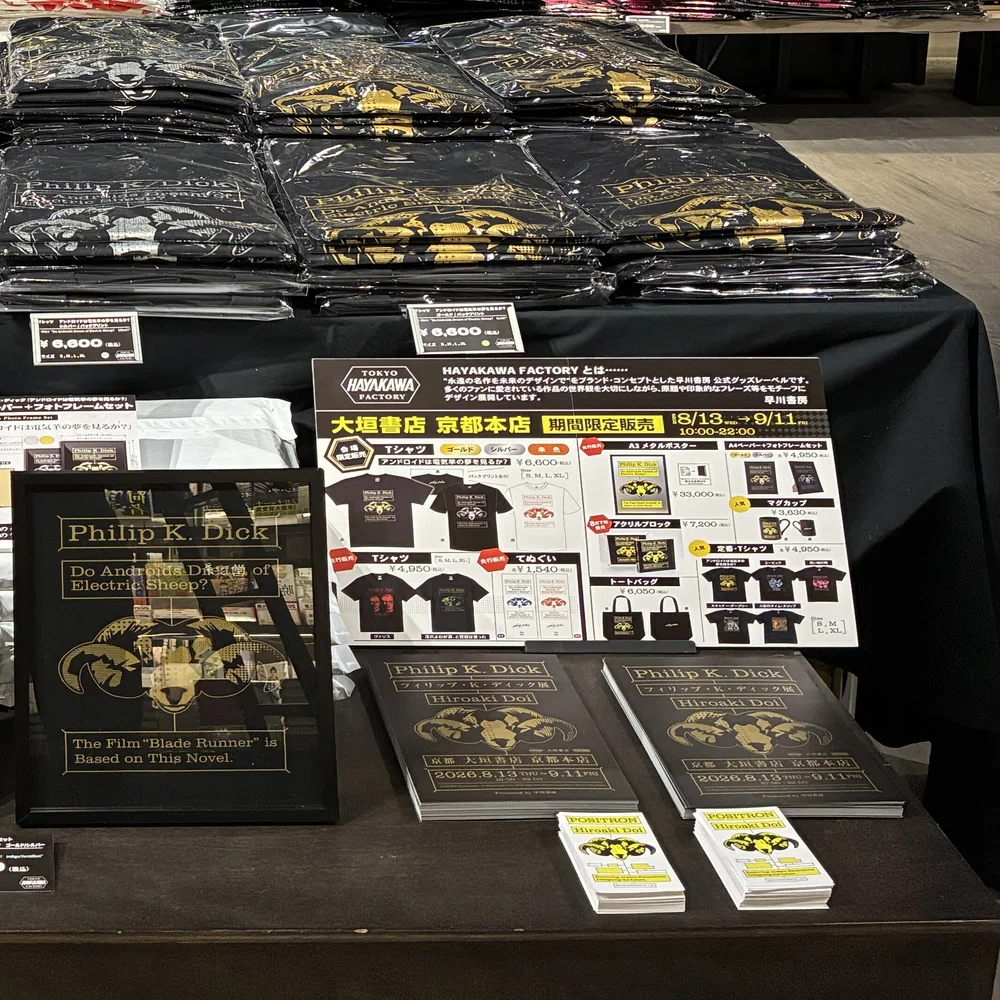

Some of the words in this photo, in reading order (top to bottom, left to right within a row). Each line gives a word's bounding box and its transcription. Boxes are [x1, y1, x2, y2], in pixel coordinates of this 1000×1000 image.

[443, 366, 516, 375] HAYAKAWA
[519, 366, 579, 375] FACTORY
[347, 378, 414, 391] HAYAKAWA
[764, 396, 808, 405] 早川書房
[677, 412, 723, 426] 8/13
[753, 412, 797, 426] 9/11
[331, 416, 426, 434] 大垣書店
[436, 416, 531, 434] 京都本店
[548, 418, 655, 432] 期間限定販売
[679, 427, 756, 436] 10:00-22:00
[384, 445, 426, 454] Tシャツ
[613, 520, 671, 528] アクリルブロック
[68, 525, 154, 544] Philip
[163, 524, 192, 541] K.
[202, 524, 269, 540] Dick
[371, 554, 409, 563] Tシャツ
[515, 553, 557, 563] てぬぐい
[70, 566, 95, 577] Do
[100, 565, 181, 576] Androids
[253, 564, 270, 576] of
[71, 580, 140, 591] Electric
[146, 579, 207, 592] Sheep?
[394, 665, 457, 675] Philip
[463, 665, 486, 673] K.
[492, 665, 542, 673] Dick
[633, 670, 698, 680] Philip
[703, 669, 728, 678] K.
[732, 669, 784, 678] Dick
[430, 695, 499, 703] Hiroaki
[502, 695, 535, 703] Doi
[678, 699, 746, 707] Hiroaki
[750, 699, 781, 707] Doi
[73, 739, 101, 749] The
[106, 738, 140, 749] Film
[196, 737, 259, 748] Runner”
[265, 737, 277, 747] is
[74, 754, 119, 764] Based
[148, 753, 181, 764] This
[186, 753, 233, 763] Novel.
[430, 756, 454, 765] 京都
[465, 755, 522, 764] 大垣書店
[532, 755, 590, 764] 京都本店
[691, 760, 715, 768] 京都
[792, 759, 851, 767] 京都本店
[435, 770, 518, 779] 2026.8.13
[548, 770, 583, 778] 9.11
[699, 774, 781, 782] 2026.8.13
[707, 812, 774, 820] POSITRON
